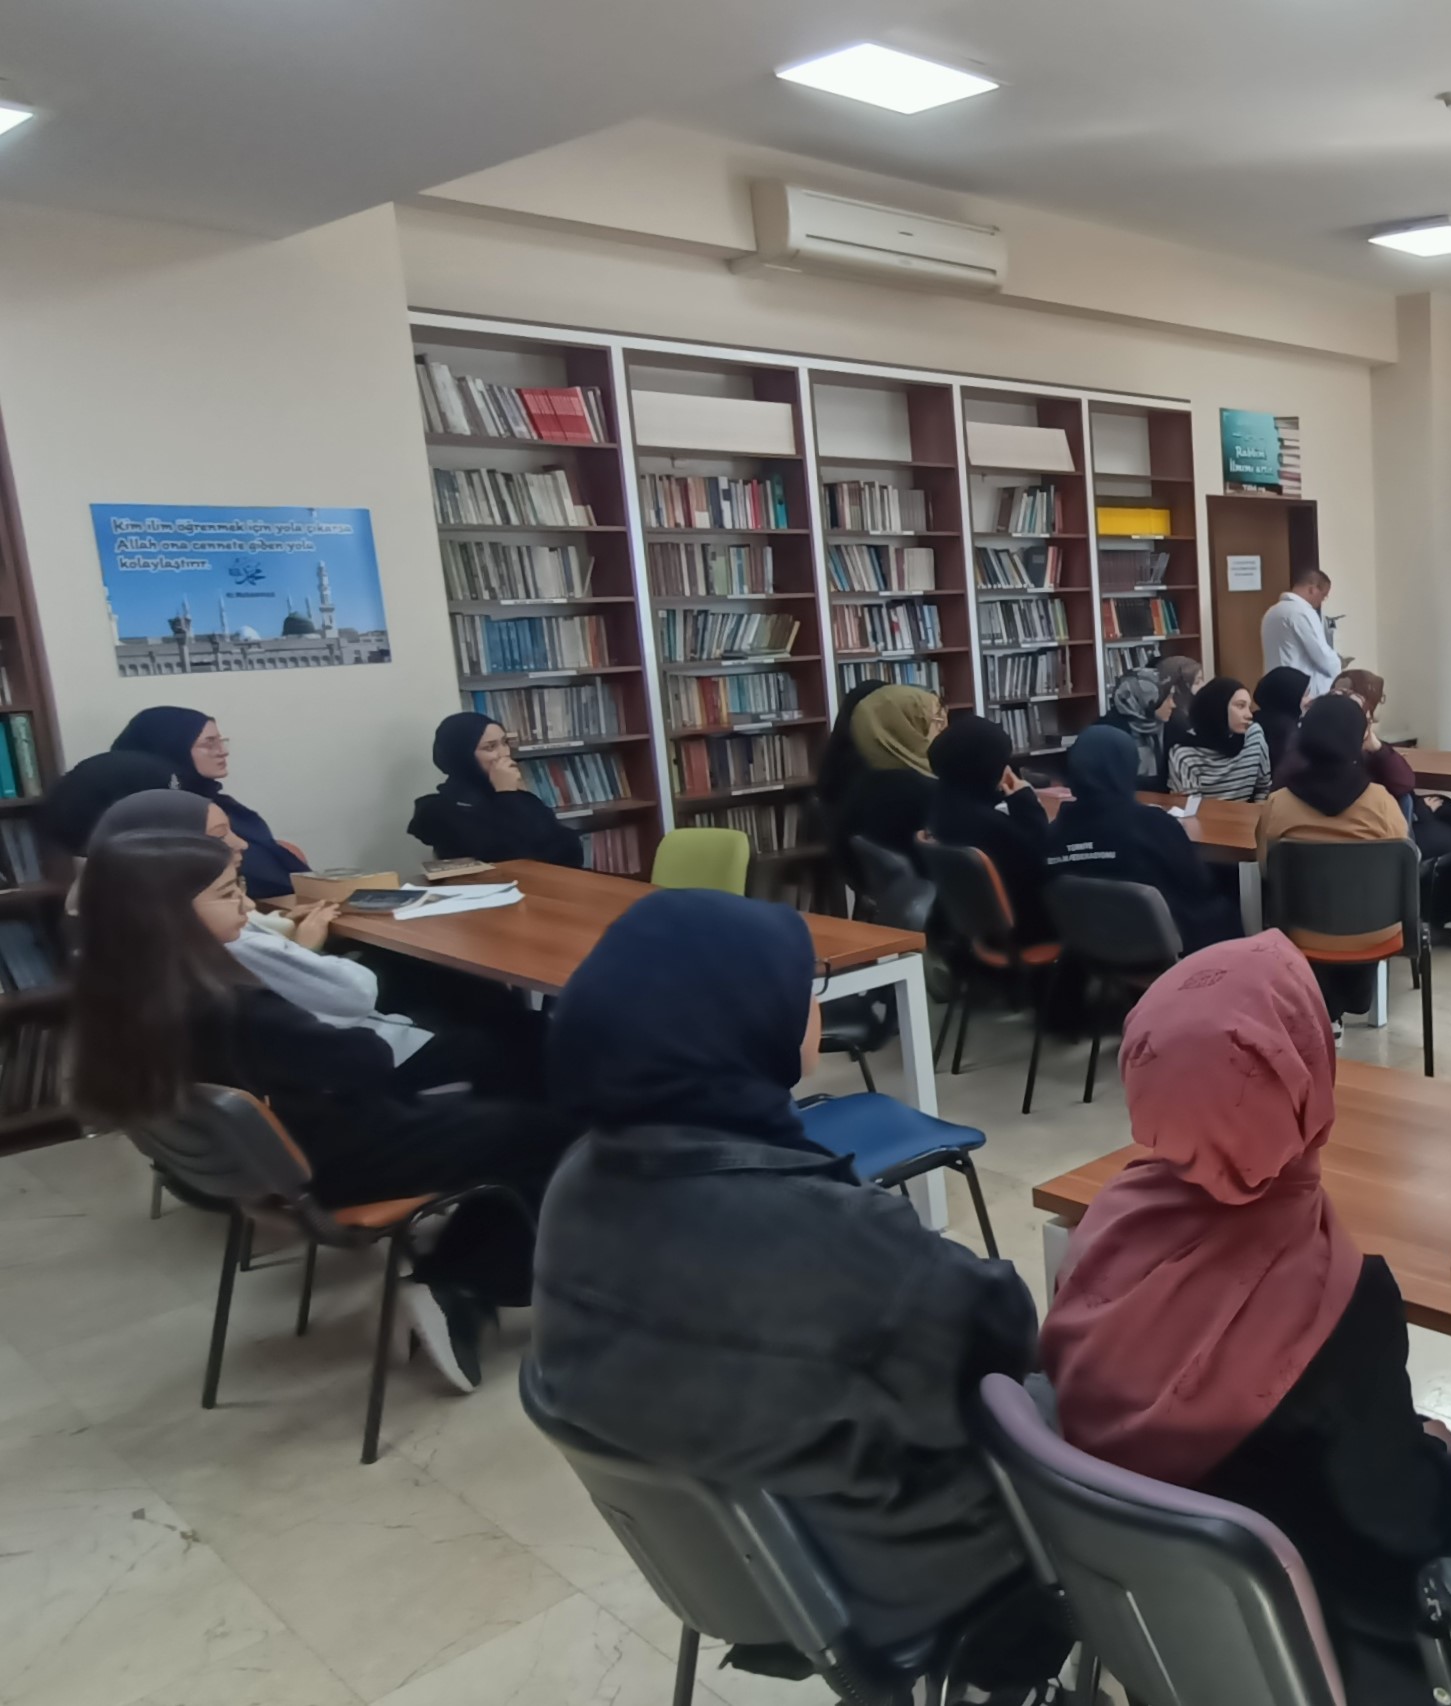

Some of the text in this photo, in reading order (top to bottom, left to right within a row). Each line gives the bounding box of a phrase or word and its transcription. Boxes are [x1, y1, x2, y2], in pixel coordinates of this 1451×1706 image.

[112, 518, 142, 533] Kim
[275, 521, 302, 534] yola
[116, 537, 314, 553] Allah ona cennete giden yolu
